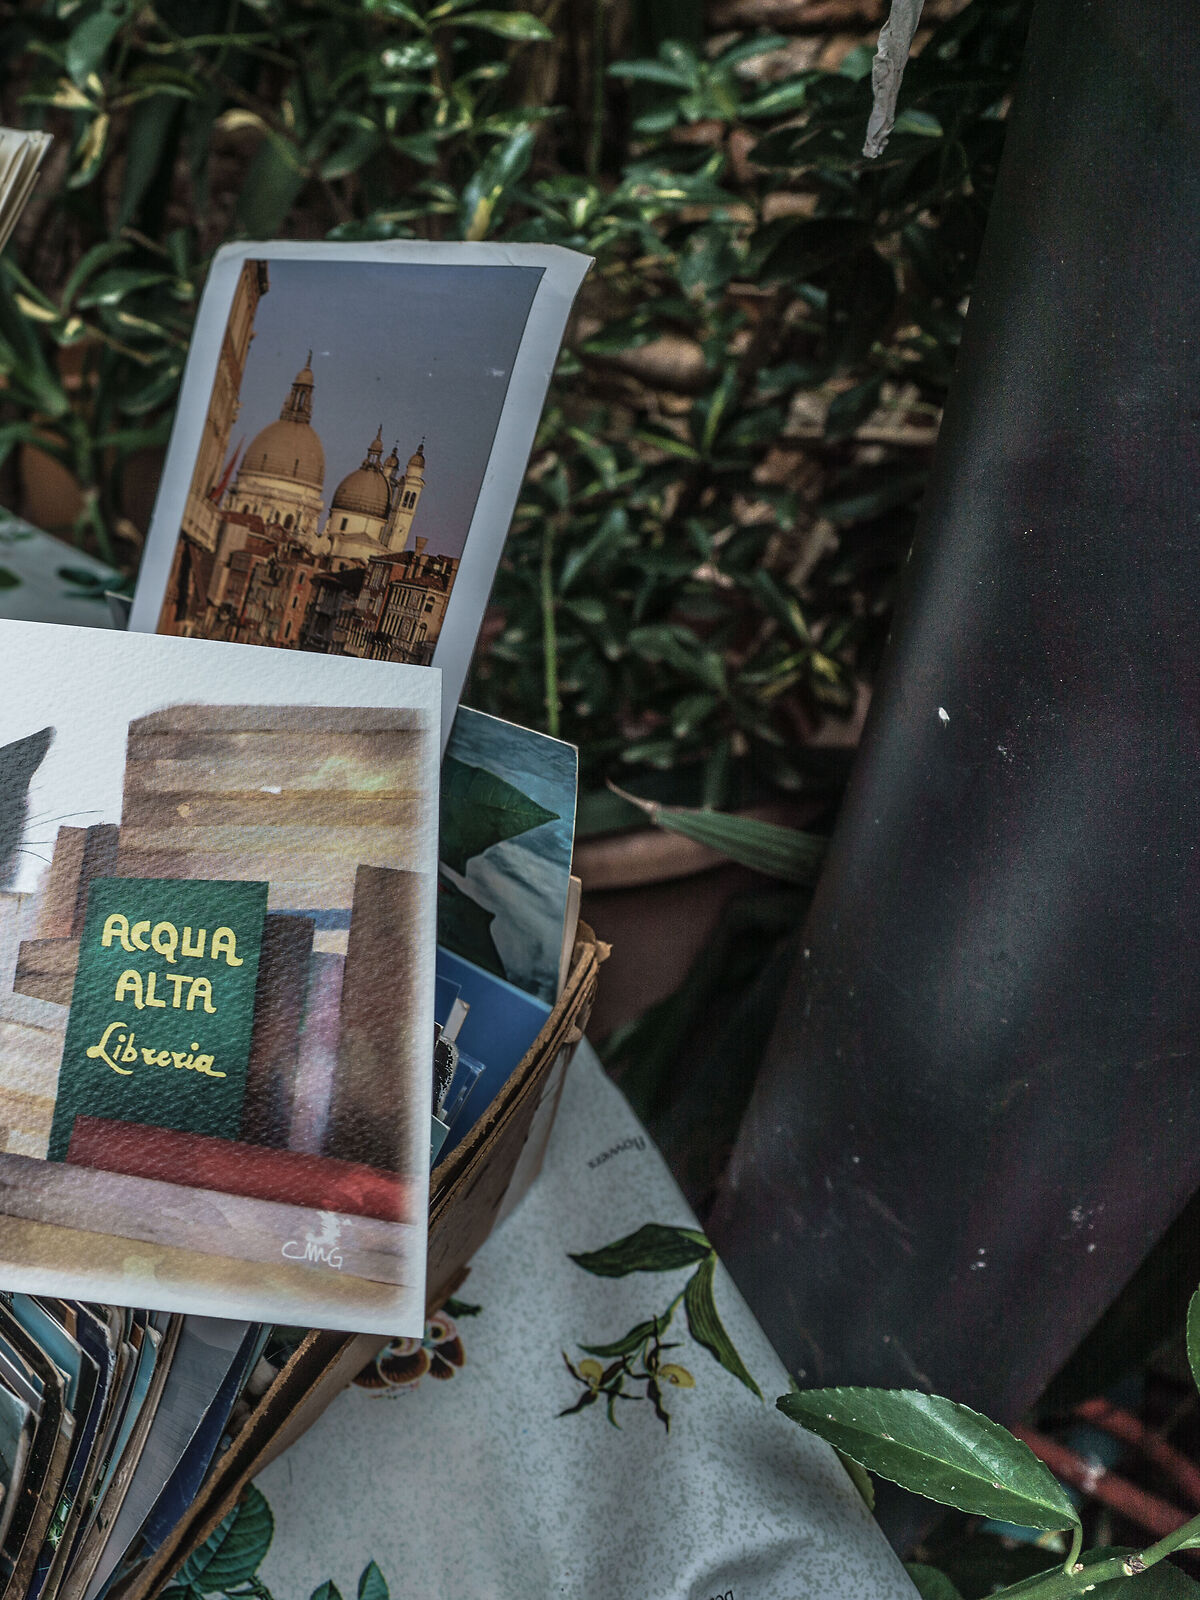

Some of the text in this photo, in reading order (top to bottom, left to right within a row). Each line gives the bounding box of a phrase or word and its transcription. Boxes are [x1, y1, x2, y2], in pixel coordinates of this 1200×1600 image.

[101, 913, 244, 967] ACQUA
[114, 969, 217, 1014] ALTA
[86, 1021, 227, 1078] Libreria
[587, 1136, 646, 1169] flowers
[281, 1241, 343, 1270] CMG
